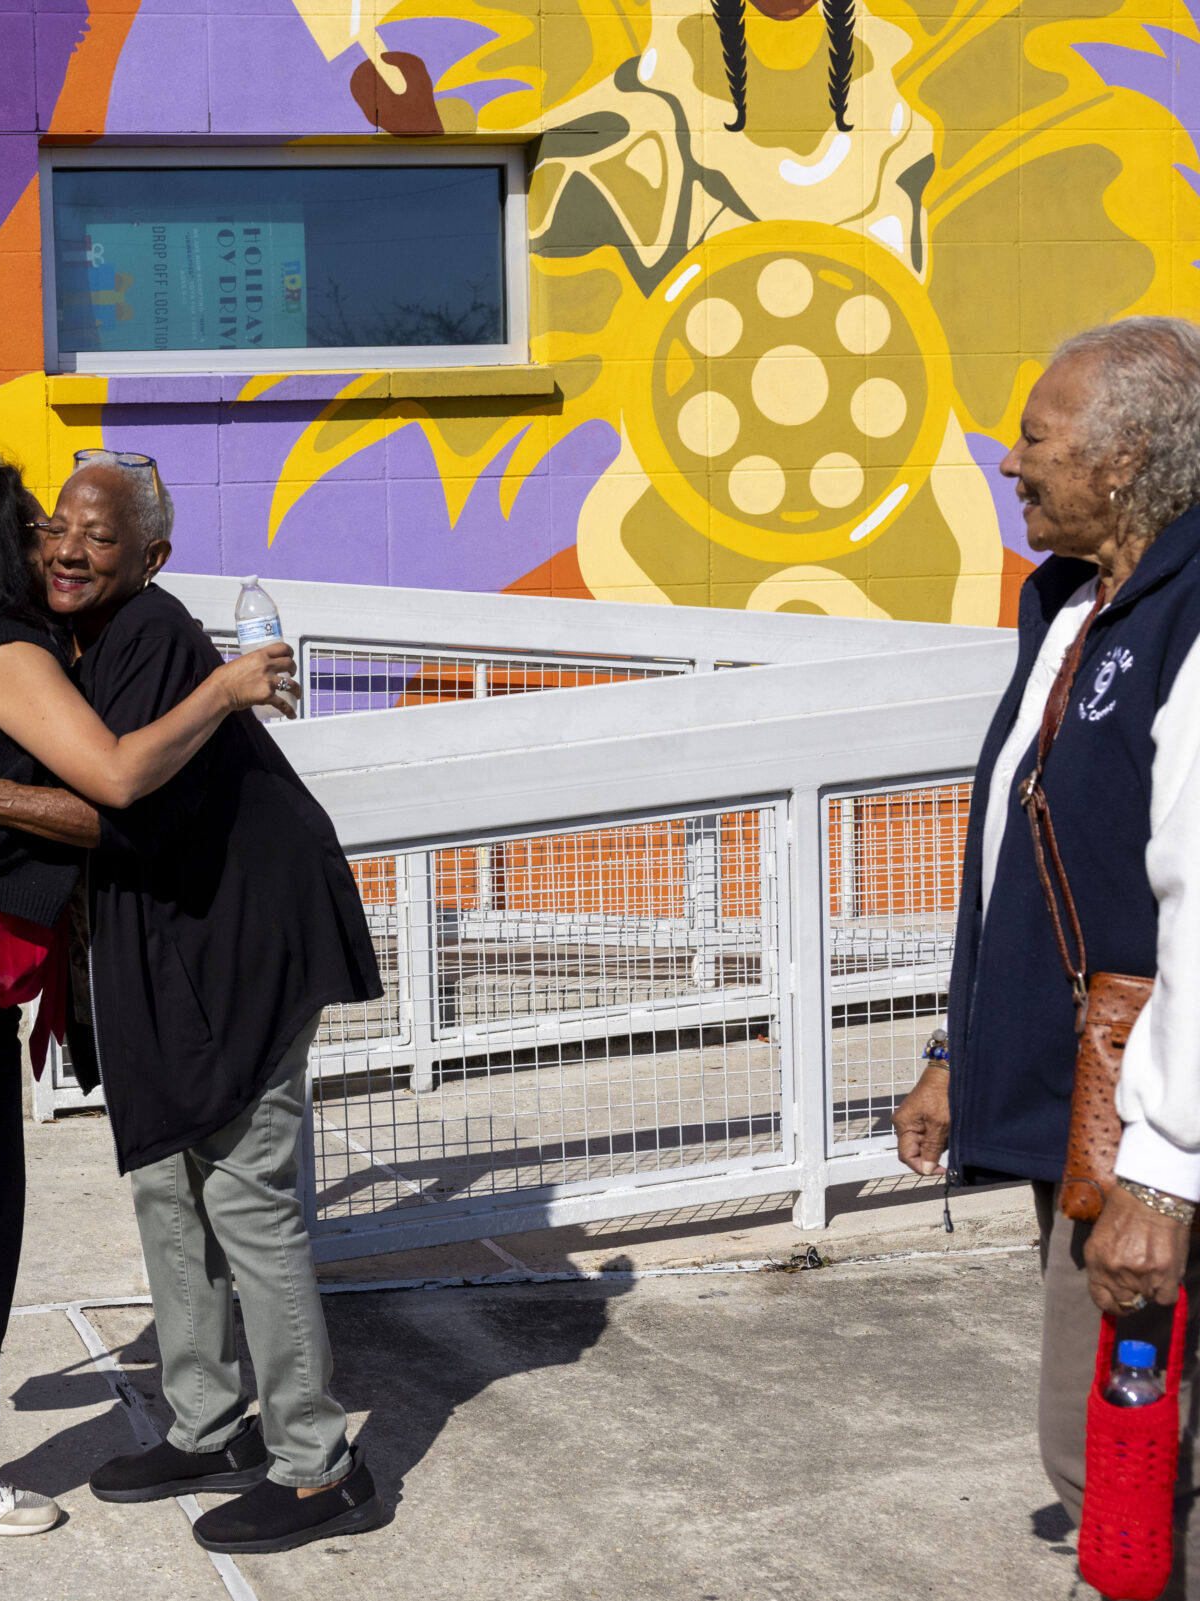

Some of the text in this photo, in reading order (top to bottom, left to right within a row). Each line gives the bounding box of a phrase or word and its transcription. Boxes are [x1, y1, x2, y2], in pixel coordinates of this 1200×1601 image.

[152, 225, 167, 259] DROP
[153, 264, 168, 287] OFF
[243, 228, 263, 348] HOLIDAY
